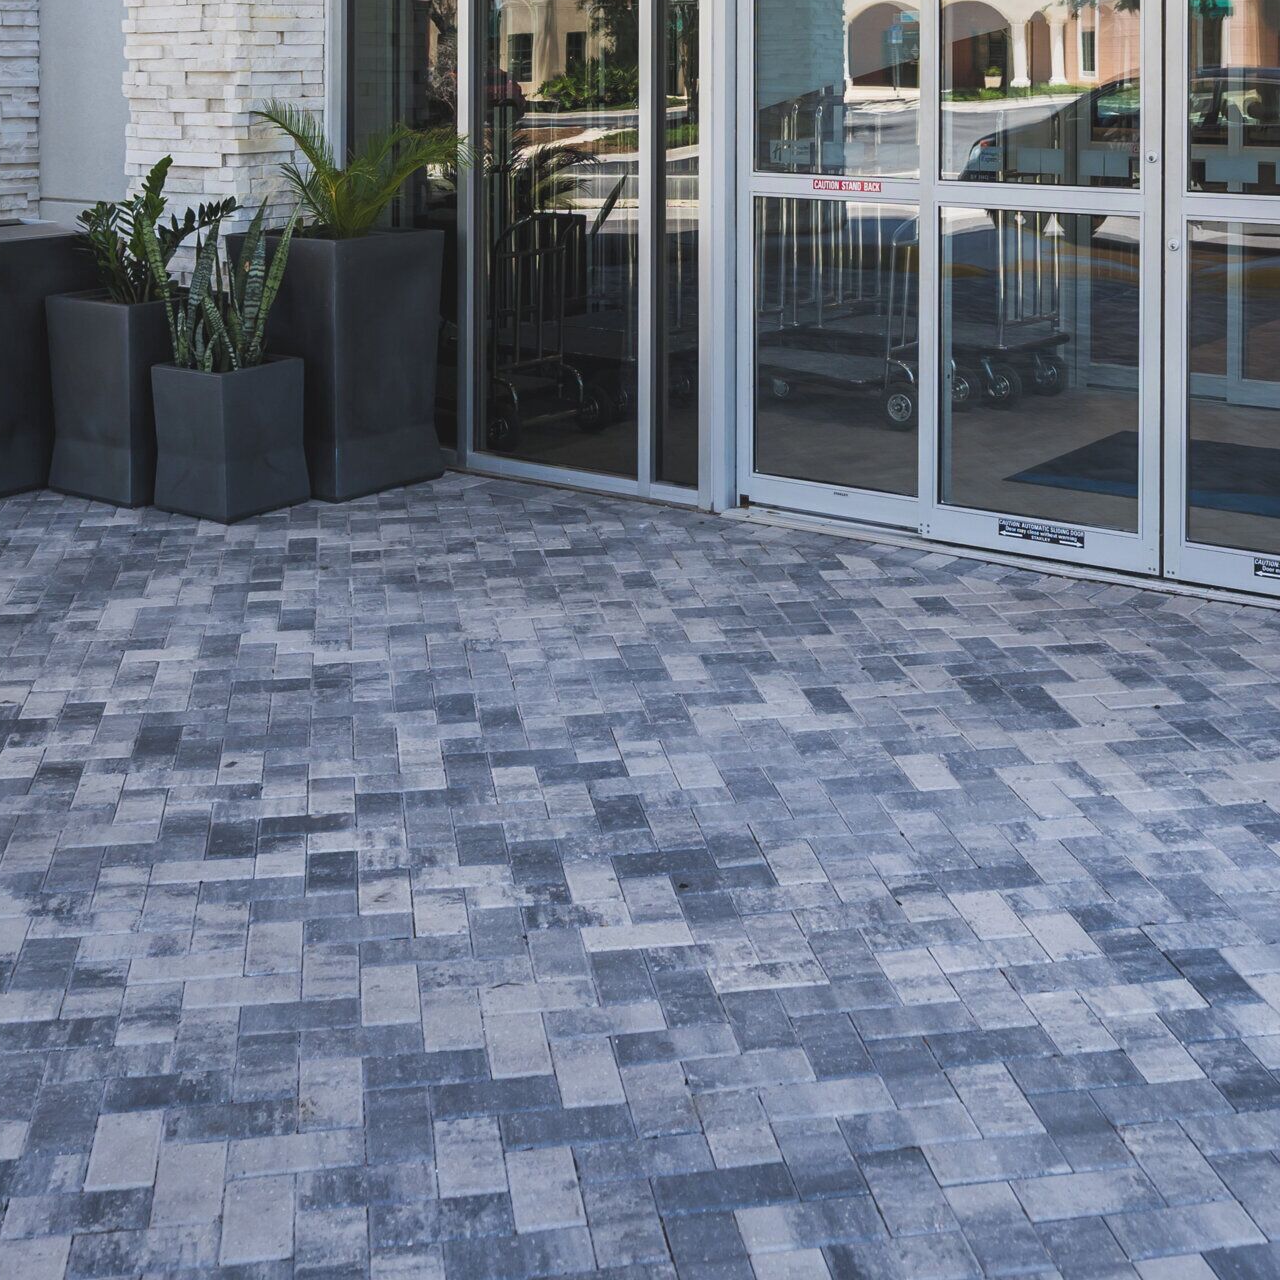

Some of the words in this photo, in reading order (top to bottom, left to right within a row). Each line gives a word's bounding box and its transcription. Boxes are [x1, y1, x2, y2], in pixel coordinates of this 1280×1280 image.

[813, 179, 839, 190] CAUTION
[841, 180, 862, 191] STAND
[863, 182, 881, 192] BACK
